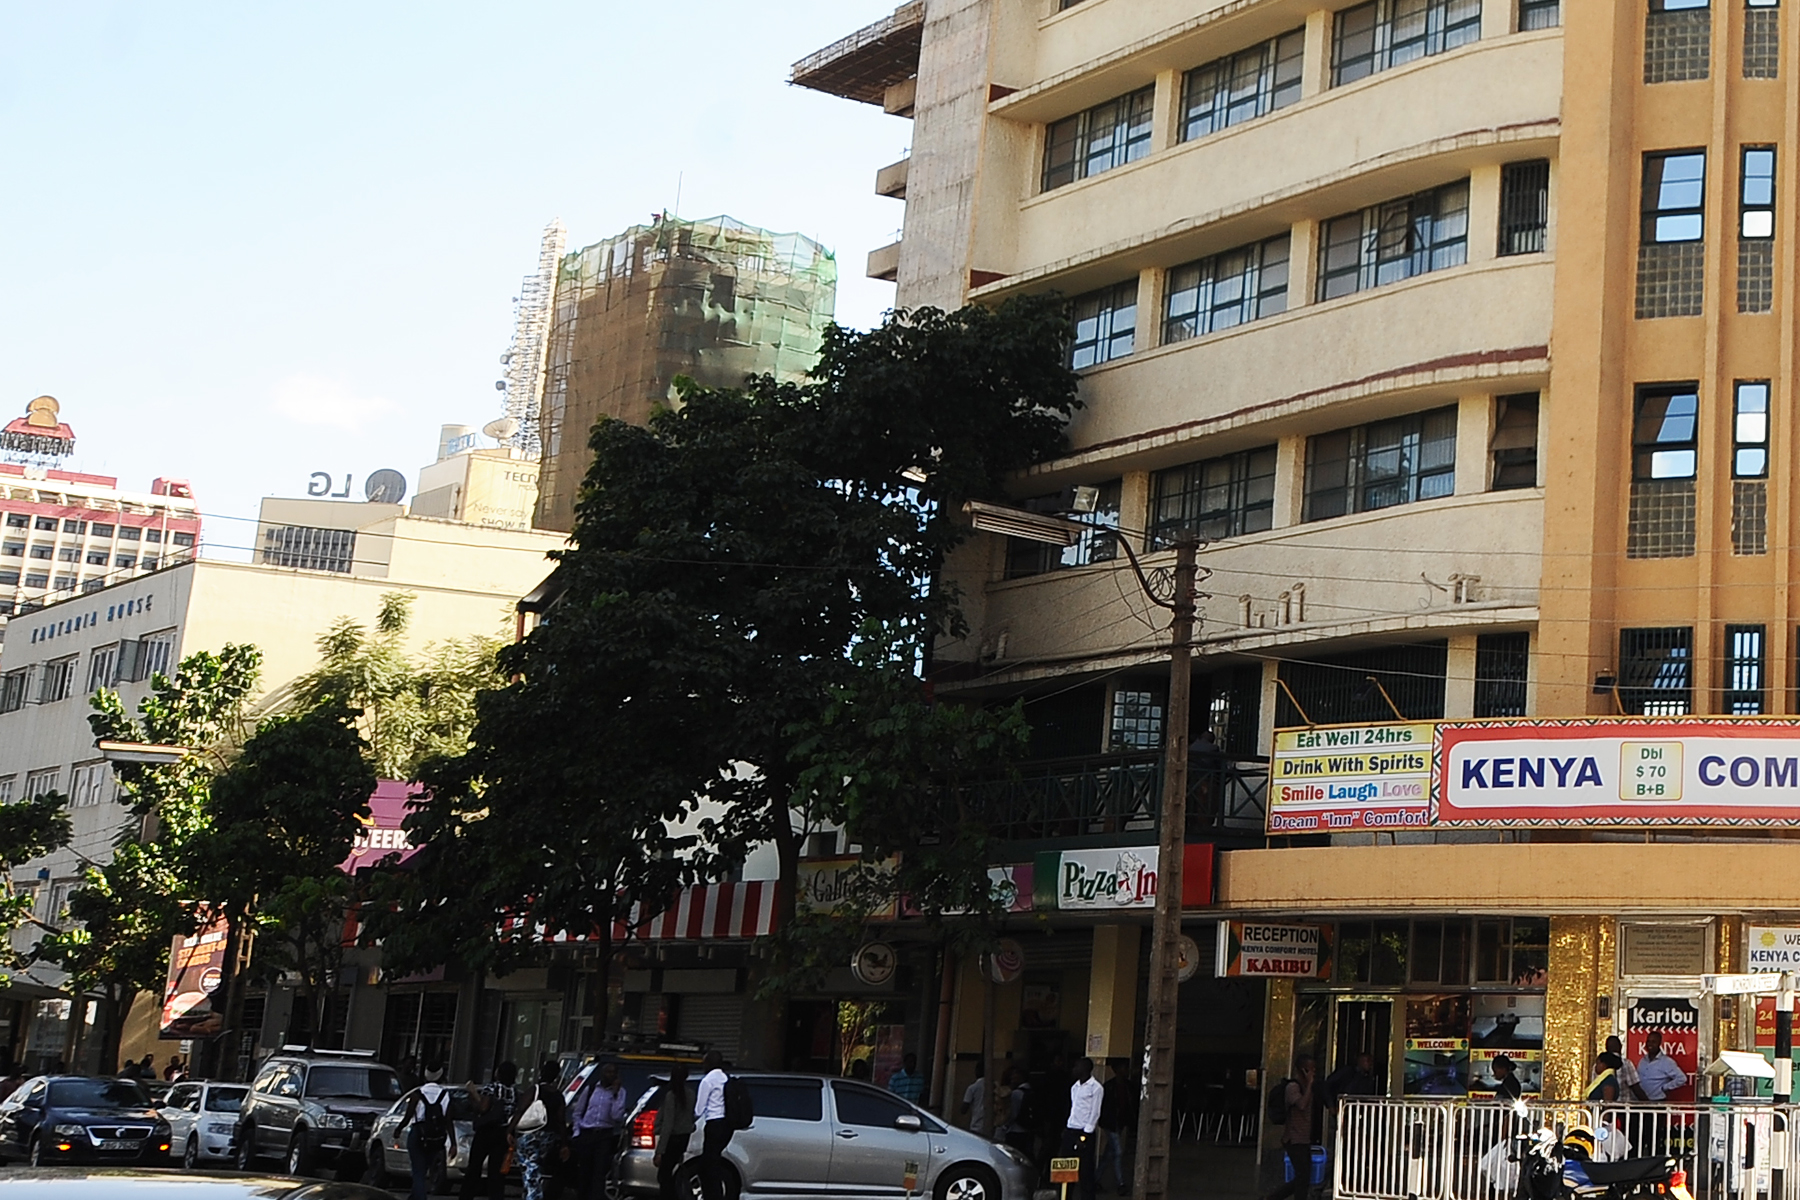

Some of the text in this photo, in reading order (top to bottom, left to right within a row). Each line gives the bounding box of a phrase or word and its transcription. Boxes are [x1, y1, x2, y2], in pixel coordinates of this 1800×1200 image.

[107, 594, 153, 622] HOUSE
[1297, 729, 1412, 748] Eat Well 24hrs
[1641, 748, 1663, 760] Dbl
[1283, 754, 1424, 775] Drink With Spirits
[1461, 757, 1603, 789] KENYA
[1636, 765, 1666, 778] $ 70
[1281, 782, 1422, 801] Smile Laugh Love
[1636, 784, 1665, 796] B+B
[1272, 815, 1317, 829] Dream
[1364, 809, 1428, 825] Comfort
[1063, 862, 1158, 901] Pizza In
[1244, 926, 1318, 943] RECEPTION
[1241, 945, 1318, 955] KENYA COMFORT HOTEL
[1750, 950, 1789, 962] KENYA
[1246, 958, 1312, 974] KARIBU
[1633, 1007, 1693, 1024] Karibu
[1759, 1011, 1773, 1020] 24
[1416, 1040, 1456, 1049] WELCOME
